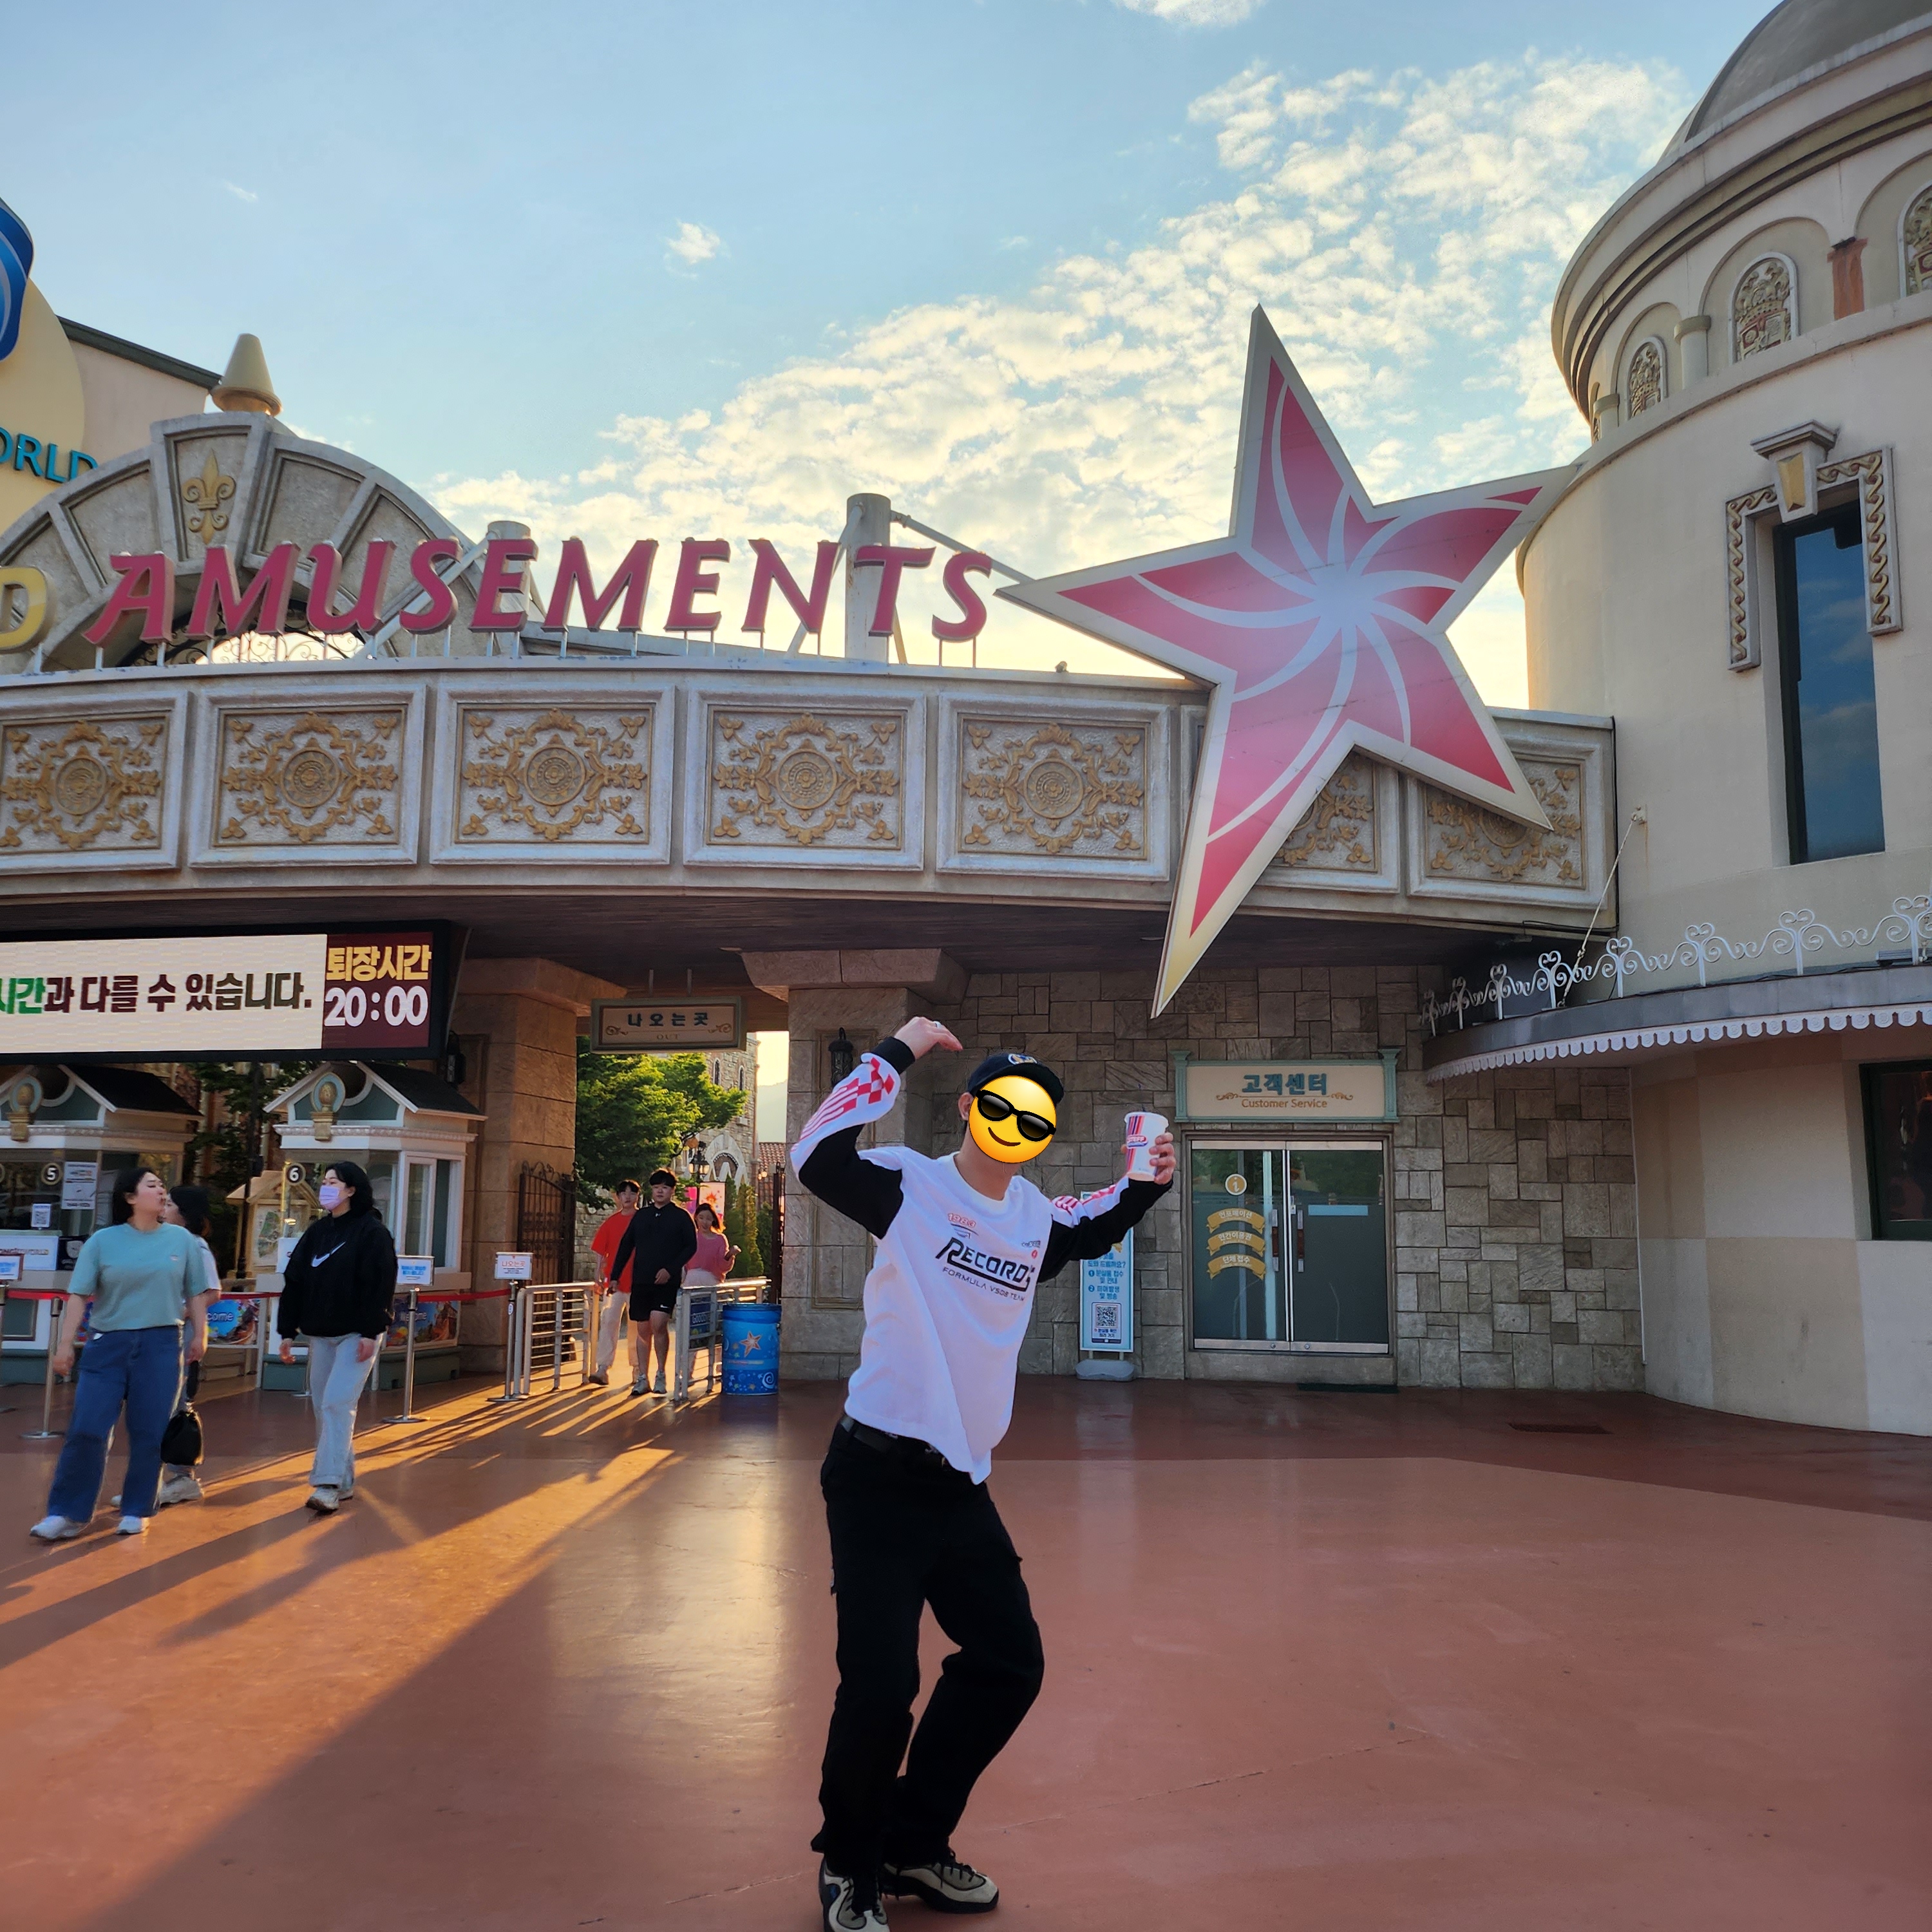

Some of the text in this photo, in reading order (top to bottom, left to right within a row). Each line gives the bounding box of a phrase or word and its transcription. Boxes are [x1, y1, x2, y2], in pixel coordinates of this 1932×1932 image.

[83, 537, 992, 645] AMUSEMENTS
[326, 945, 432, 981] 퇴장시간
[0, 972, 312, 1014] 시간과 다를 수 있습니다.
[324, 985, 429, 1027] 20:00
[1242, 1073, 1327, 1095] 고객센터
[1242, 1099, 1327, 1108] Customer Service
[46, 1167, 57, 1180] 5
[290, 1167, 299, 1181] 6
[943, 1267, 987, 1290] FORMULA
[207, 1311, 234, 1321] come
